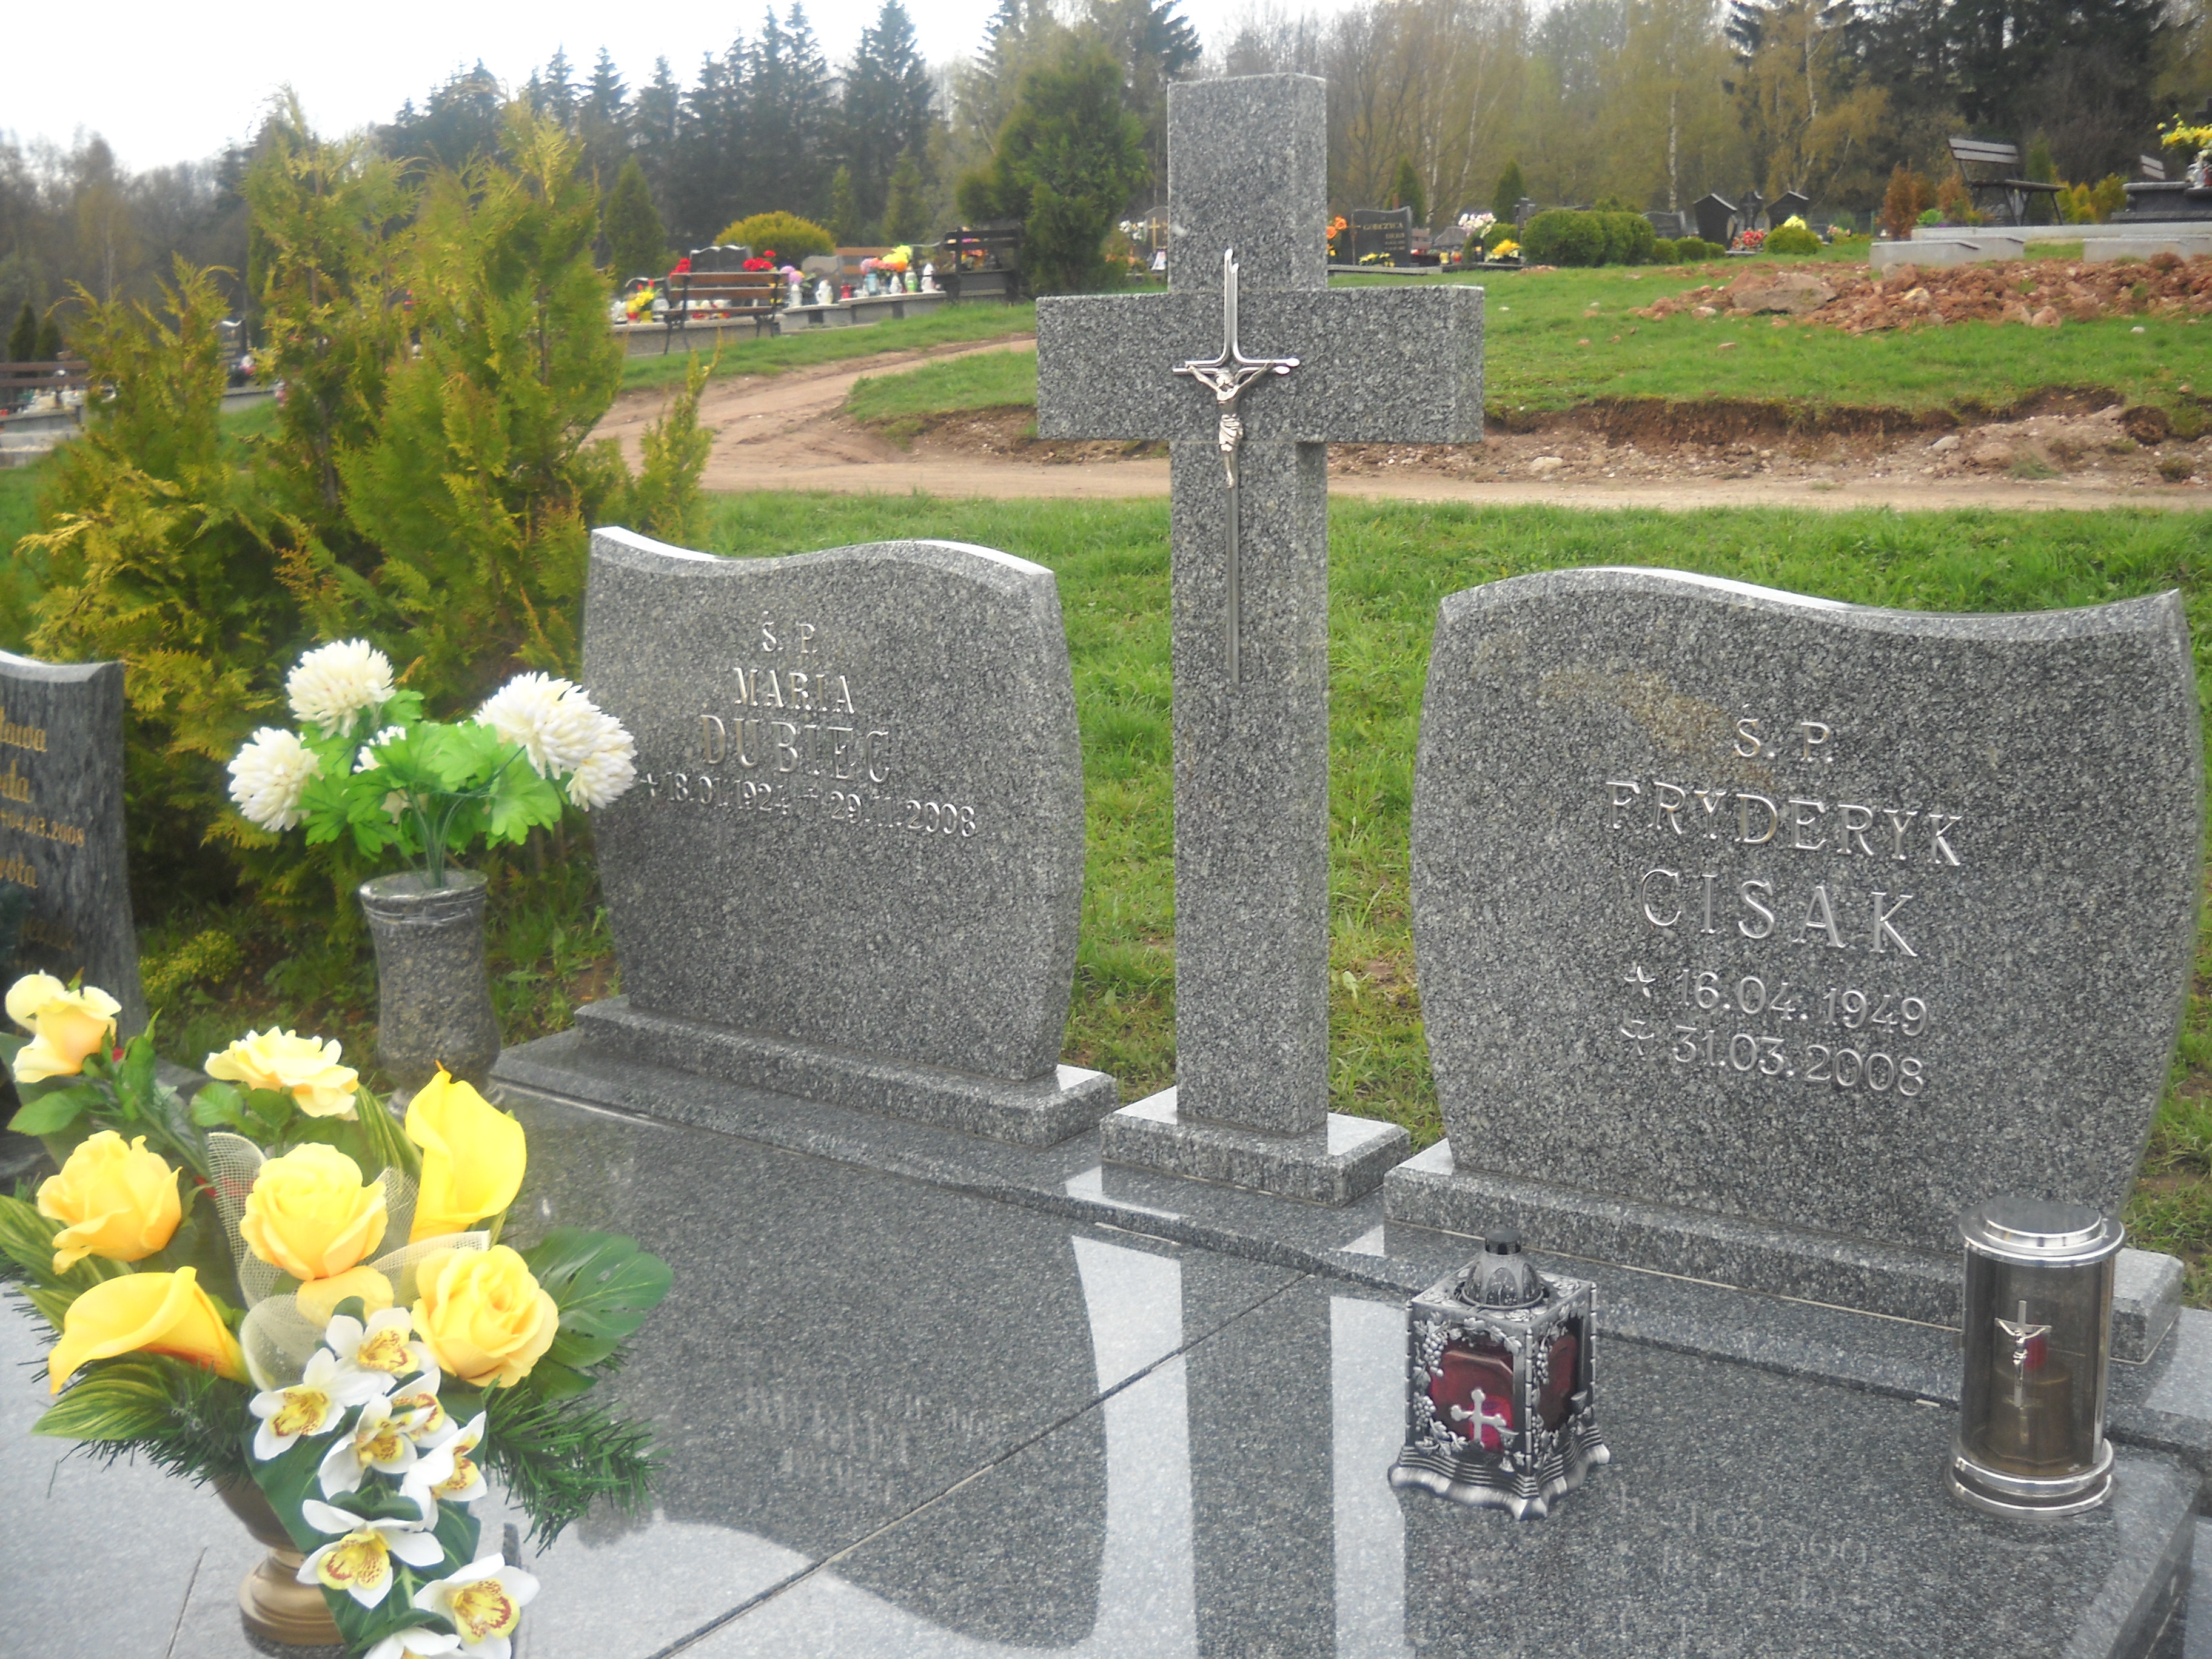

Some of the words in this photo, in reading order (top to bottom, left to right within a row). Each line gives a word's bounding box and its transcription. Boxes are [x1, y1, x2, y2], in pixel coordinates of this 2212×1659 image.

[799, 623, 818, 654] P.
[732, 667, 855, 714] MARIA
[700, 714, 890, 782] DUBIEC
[1800, 721, 1834, 762] P.
[830, 790, 976, 837] 29.11.2008
[1606, 780, 1963, 866] FRYDERYK
[1641, 868, 1918, 957] CISAK
[1676, 968, 1928, 1036] 16.04.1949
[1674, 1024, 1924, 1096] 31.03.2008
